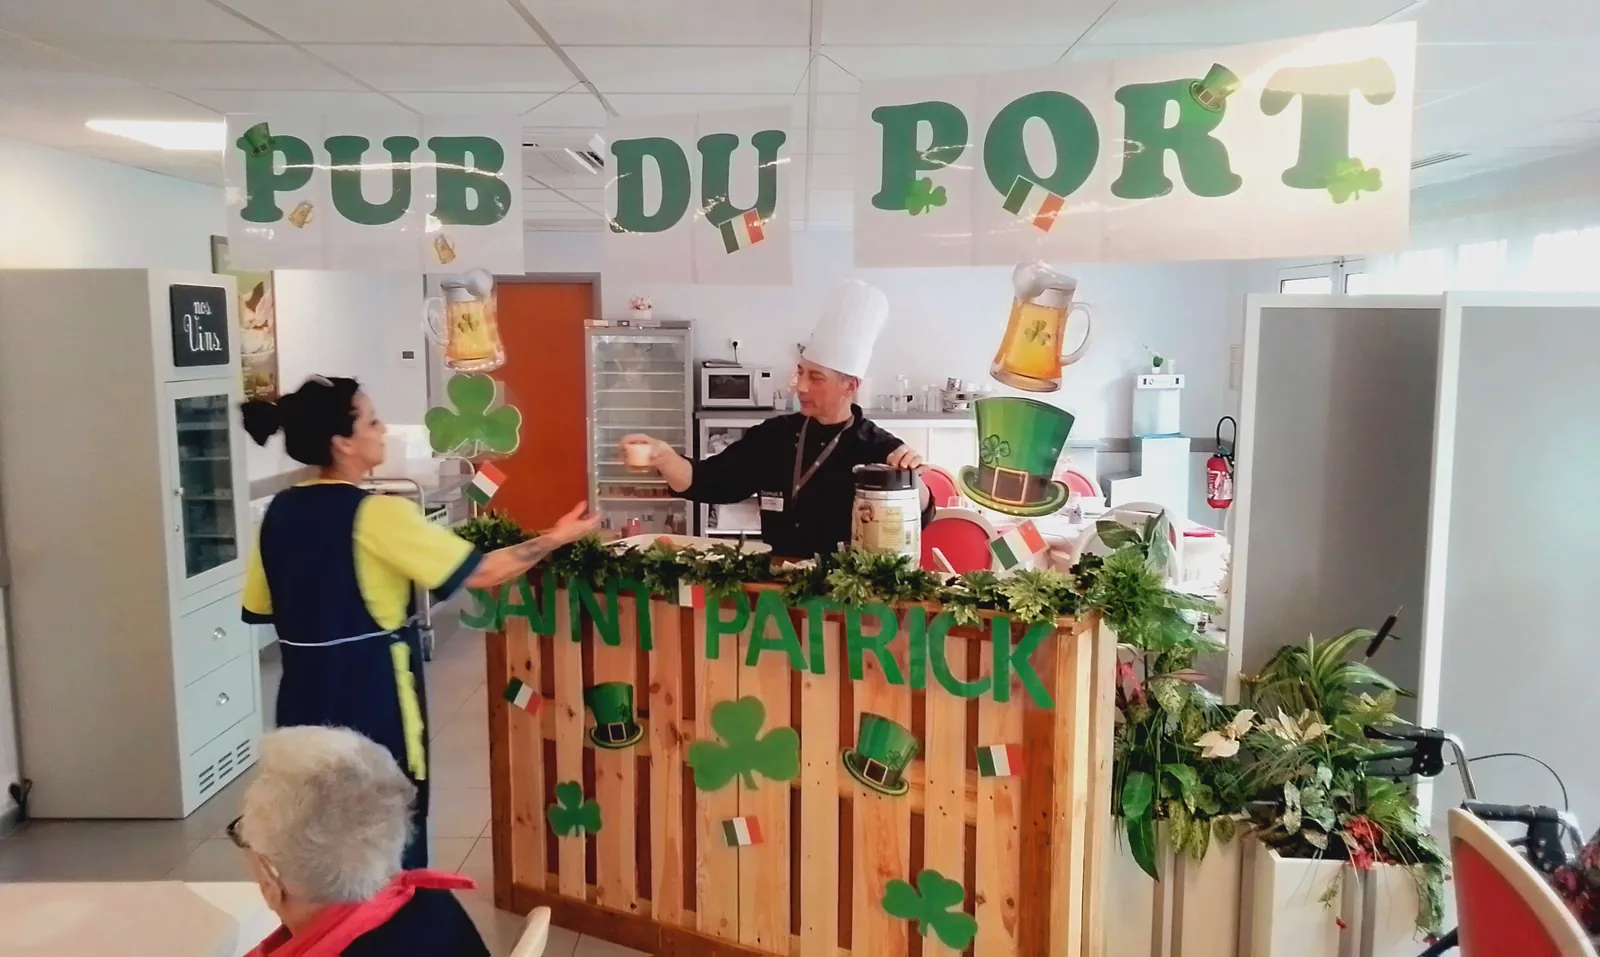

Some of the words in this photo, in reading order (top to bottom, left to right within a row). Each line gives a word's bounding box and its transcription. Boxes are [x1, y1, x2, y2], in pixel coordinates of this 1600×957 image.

[236, 135, 511, 225] PUB
[610, 130, 786, 233] DU
[871, 57, 1396, 210] PORT
[184, 314, 223, 351] Vins
[193, 302, 211, 315] nos
[705, 590, 1055, 709] PATRICK
